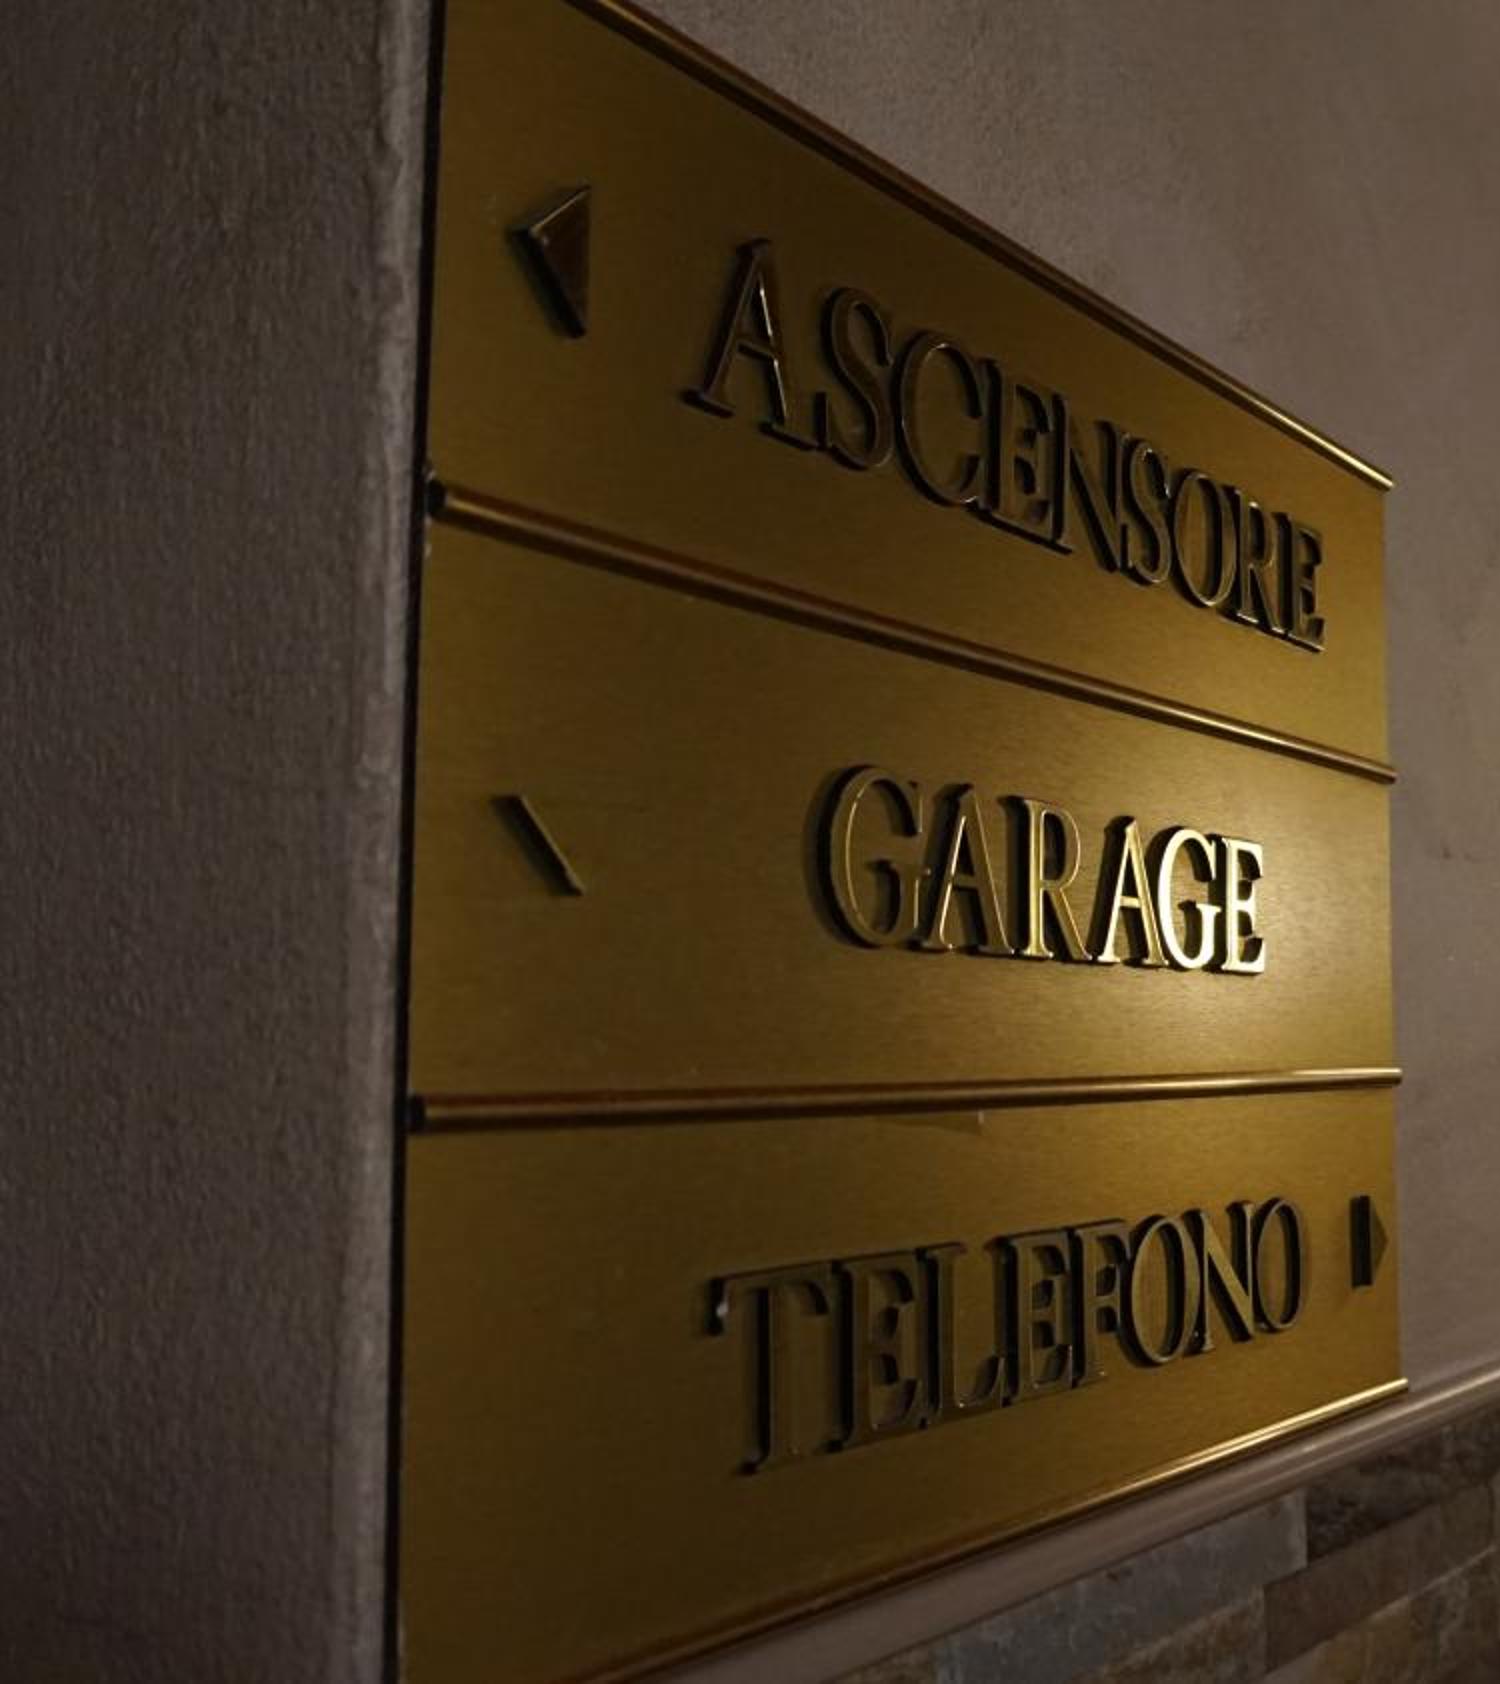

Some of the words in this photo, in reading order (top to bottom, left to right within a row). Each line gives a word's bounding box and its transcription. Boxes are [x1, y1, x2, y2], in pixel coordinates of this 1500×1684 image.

[683, 237, 1326, 654] ASCENSORE
[820, 764, 1267, 974] GARAGE
[702, 1196, 1304, 1475] TELEFONO
